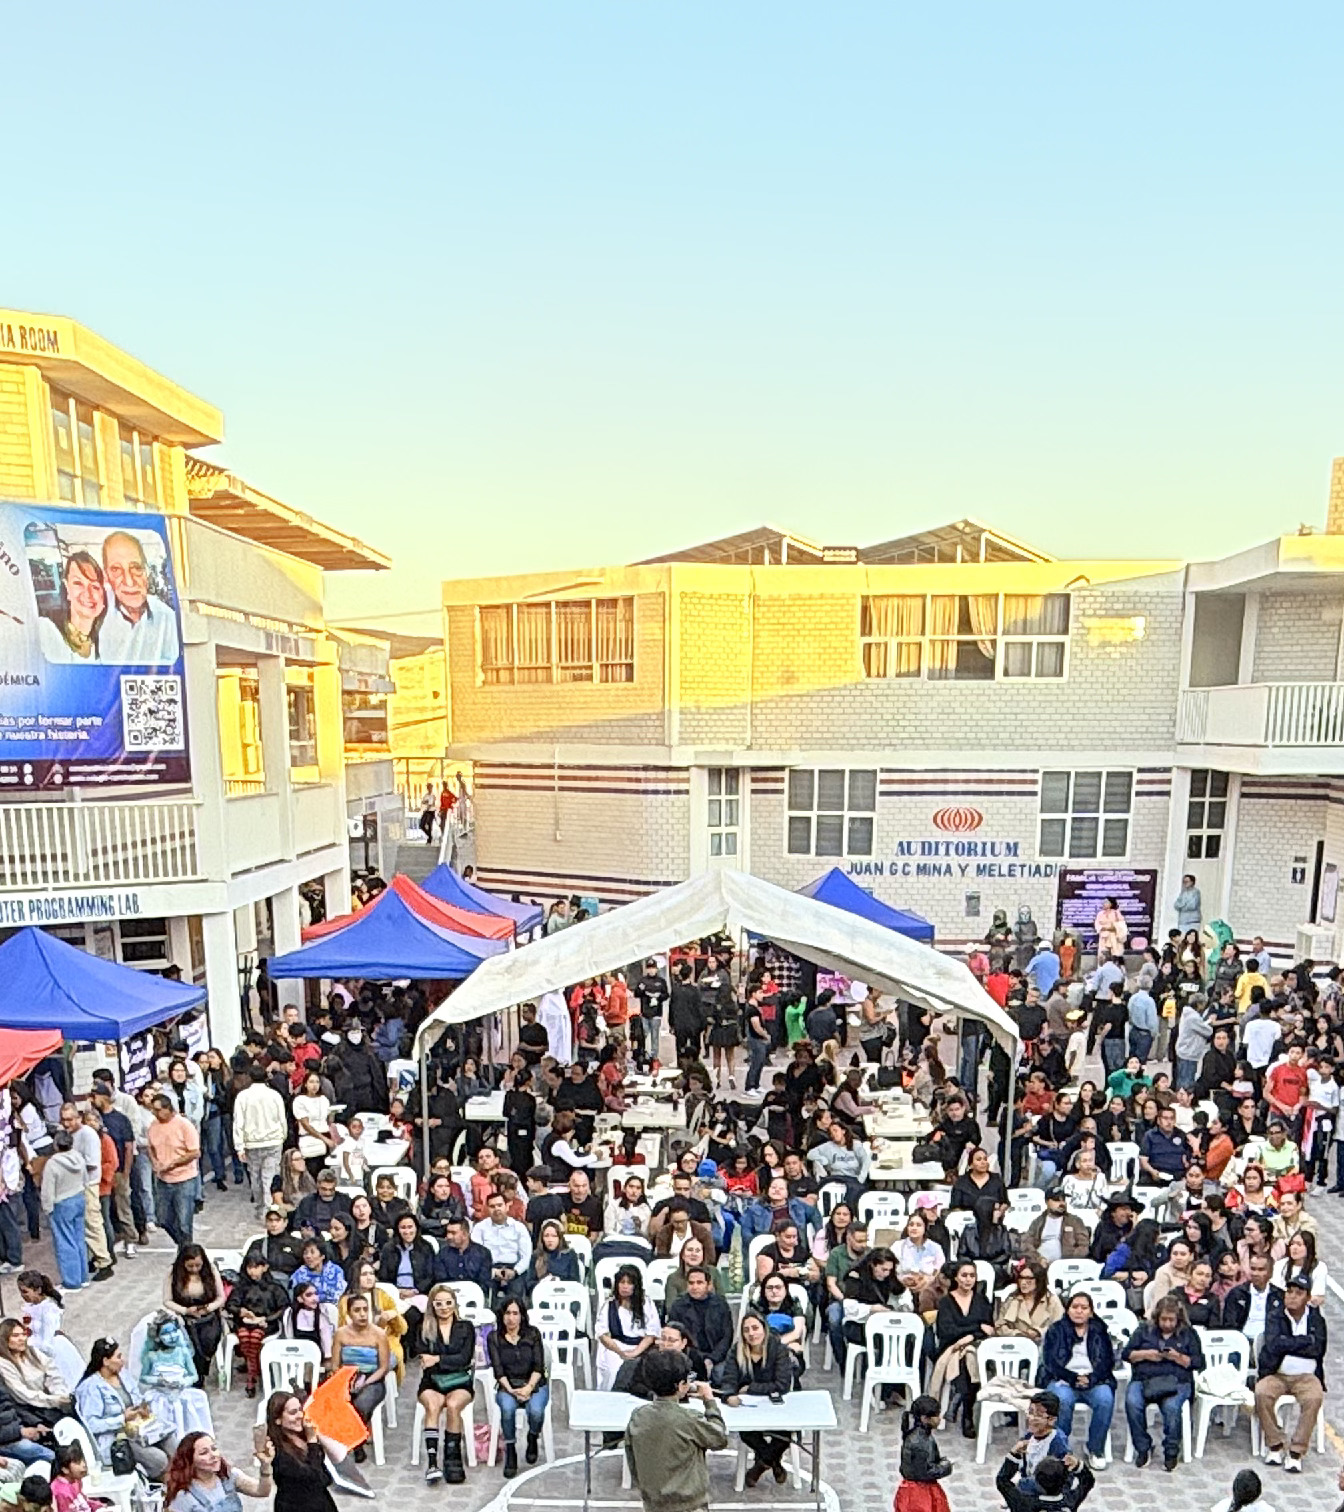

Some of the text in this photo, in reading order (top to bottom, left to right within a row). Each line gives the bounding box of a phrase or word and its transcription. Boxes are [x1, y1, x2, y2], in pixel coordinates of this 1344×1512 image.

[19, 325, 60, 353] ROOM
[895, 840, 1019, 857] AUDITORIUM
[846, 861, 884, 876] JUAN
[889, 862, 898, 876] G
[902, 862, 912, 876] C
[916, 862, 953, 877] MINA
[958, 863, 969, 877] Y
[29, 895, 116, 922] PROGRAMMING
